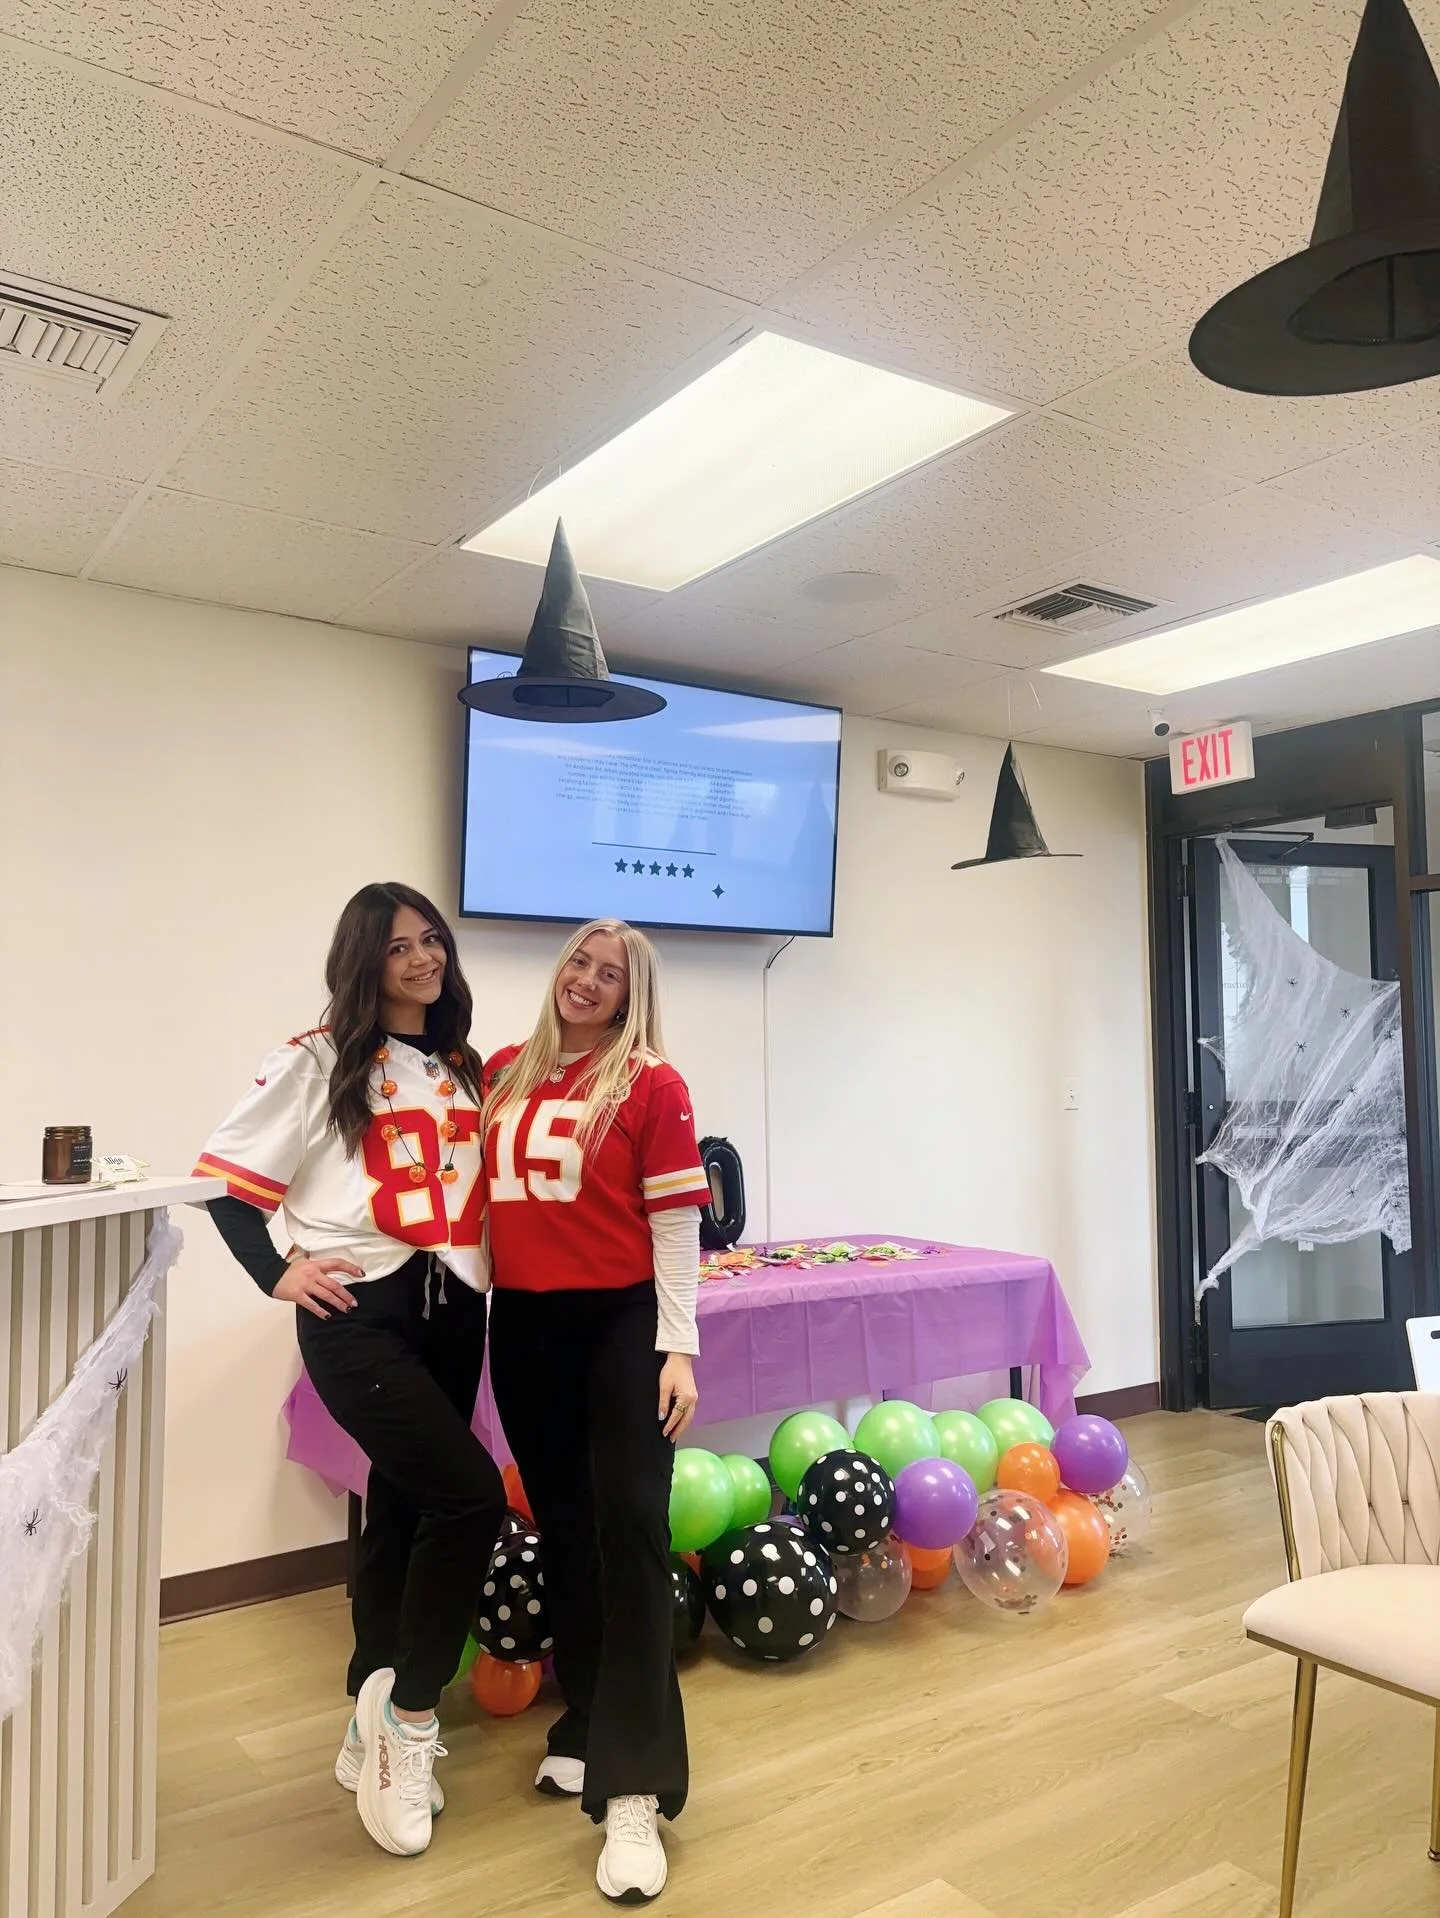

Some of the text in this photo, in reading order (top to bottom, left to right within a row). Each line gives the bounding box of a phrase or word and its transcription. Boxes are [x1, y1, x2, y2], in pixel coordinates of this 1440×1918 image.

[1181, 728, 1233, 785] EXIT
[359, 1106, 484, 1251] 87
[487, 1098, 586, 1202] 15
[378, 1734, 391, 1790] HOKA
